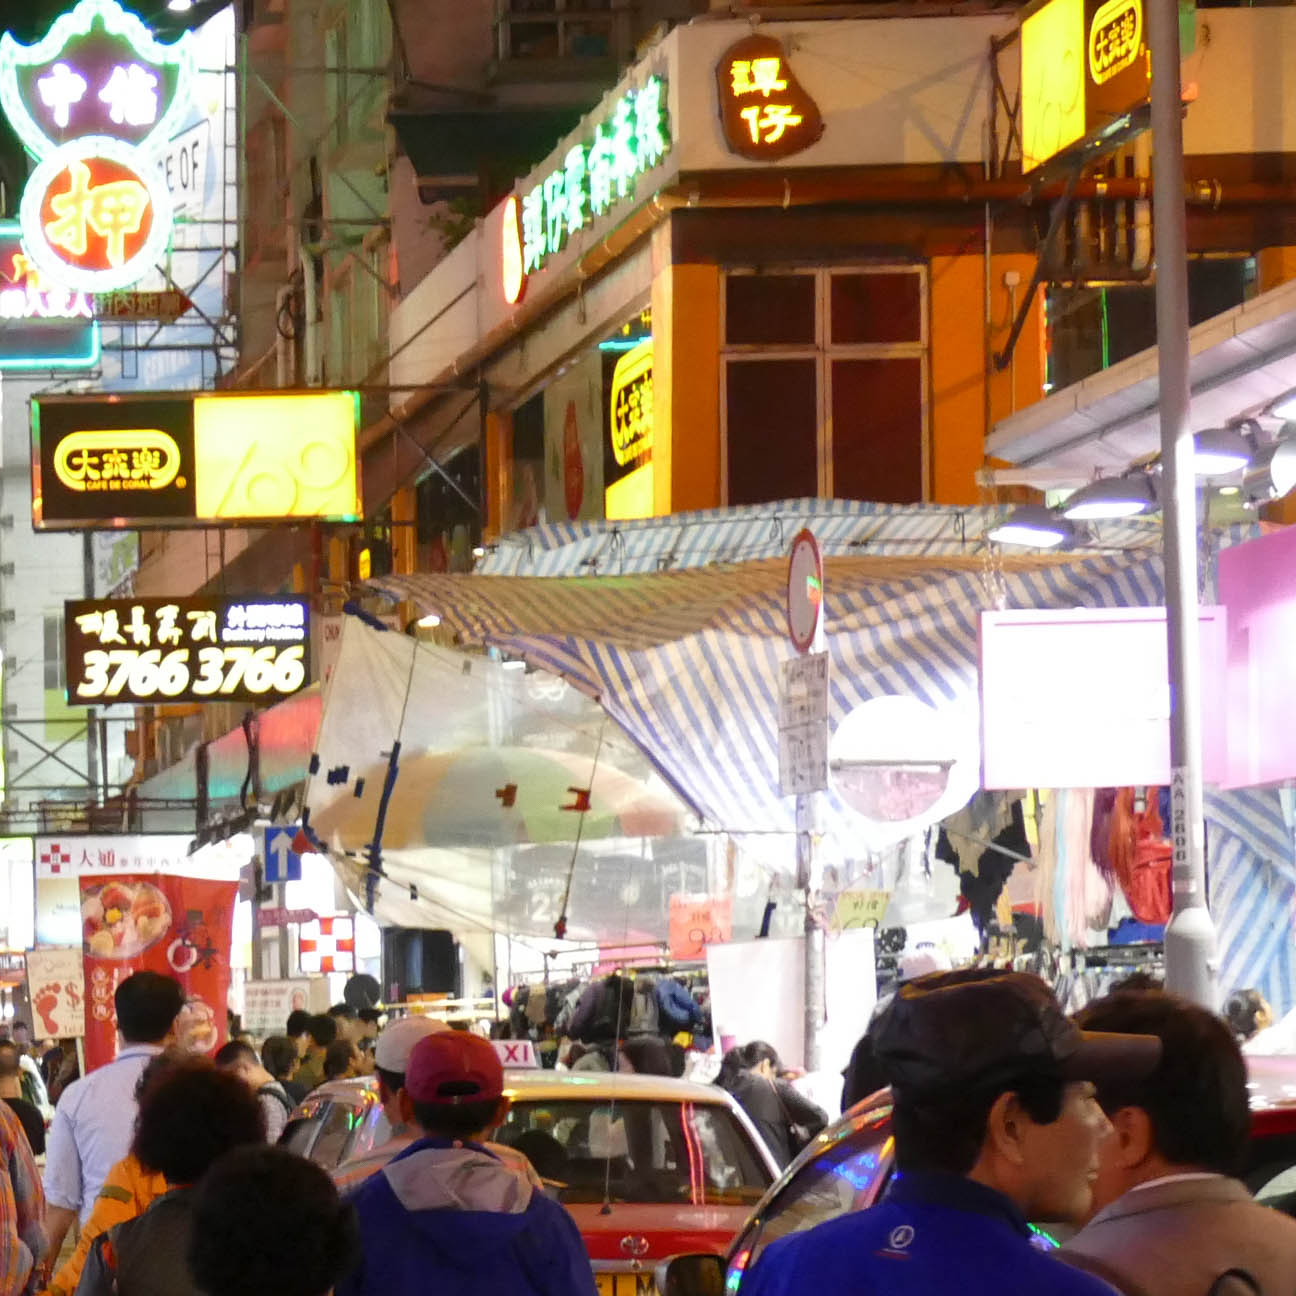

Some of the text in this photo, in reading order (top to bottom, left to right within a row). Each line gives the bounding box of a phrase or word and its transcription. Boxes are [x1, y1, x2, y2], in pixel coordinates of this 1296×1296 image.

[730, 58, 803, 145] 譚仔
[46, 158, 150, 267] 押
[76, 645, 305, 697] 3766 3766
[505, 1043, 530, 1064] XI
